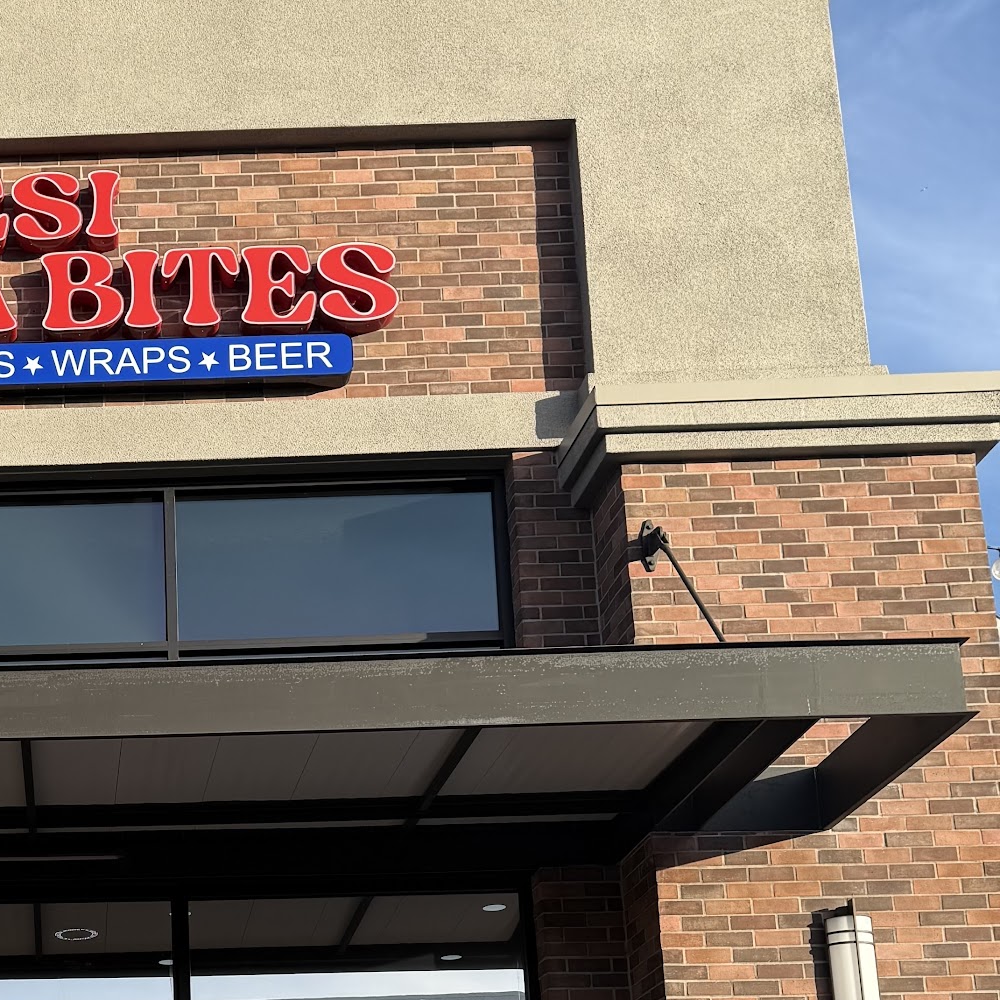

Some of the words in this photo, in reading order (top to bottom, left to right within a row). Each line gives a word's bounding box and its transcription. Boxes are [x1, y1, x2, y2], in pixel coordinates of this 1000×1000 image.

[40, 242, 401, 331] BITES
[50, 346, 191, 377] WRAPS
[228, 341, 333, 371] BEER
